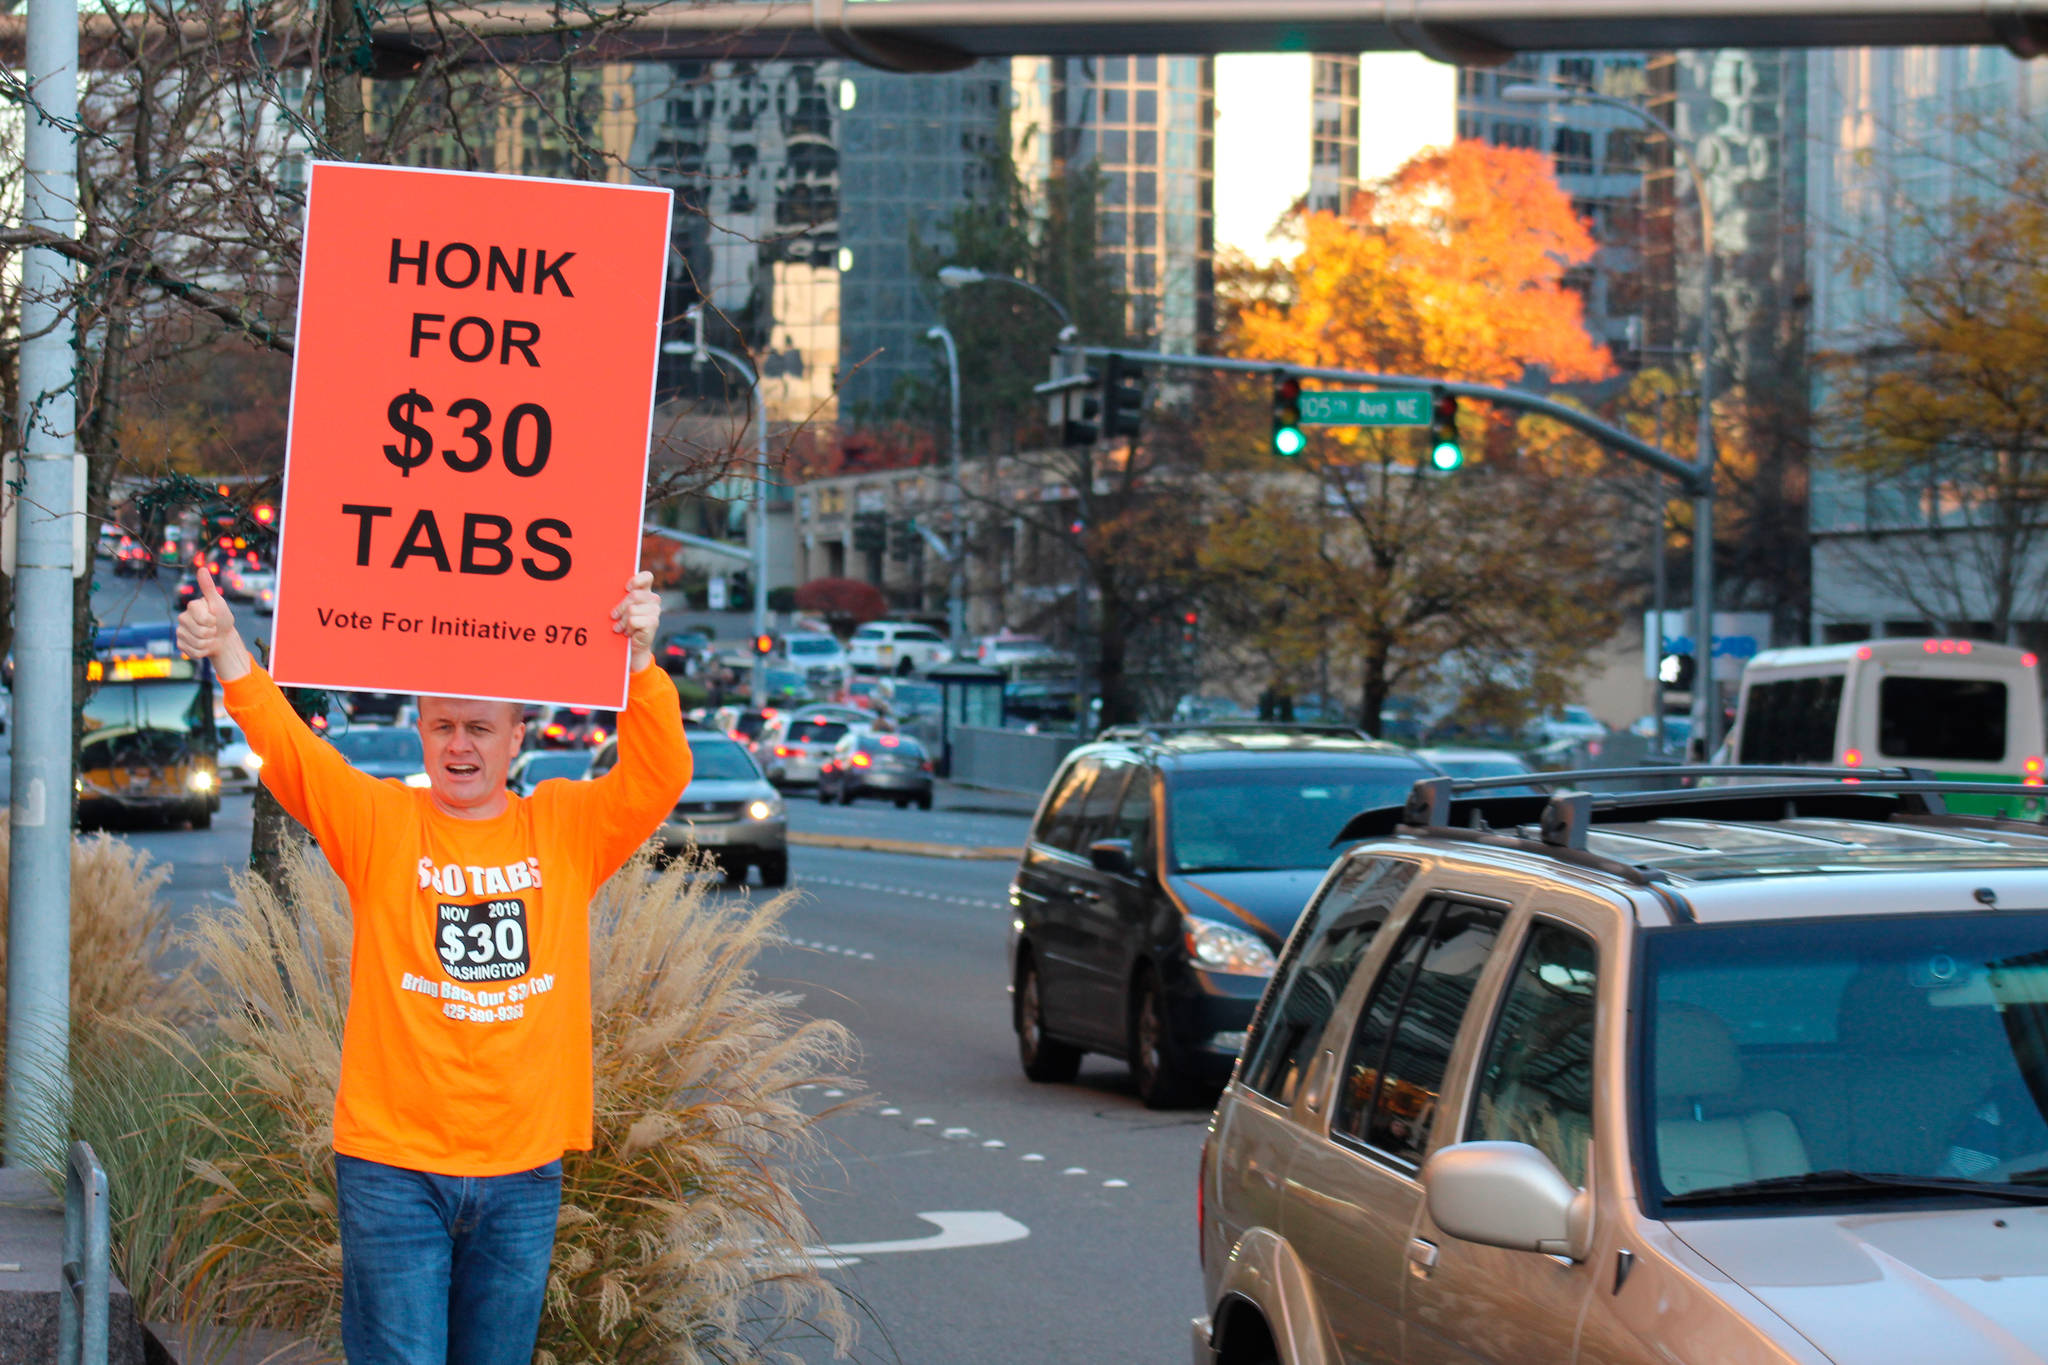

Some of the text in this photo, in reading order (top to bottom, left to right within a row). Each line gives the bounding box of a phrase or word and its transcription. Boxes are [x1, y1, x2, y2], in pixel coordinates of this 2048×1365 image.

[388, 238, 577, 298] HONK
[409, 312, 541, 368] FOR
[1358, 398, 1388, 418] Ave
[1396, 398, 1418, 419] NE
[382, 388, 552, 478] $30
[342, 503, 574, 581] TABS
[317, 608, 588, 647] Vote For Initiative 976
[466, 857, 543, 896] TABS
[440, 901, 521, 922] NOV 2019
[439, 919, 524, 965] $30
[401, 972, 439, 998] Bring
[478, 991, 507, 1007] Our
[508, 983, 530, 1003] $3
[442, 962, 525, 981] WASHINGTON
